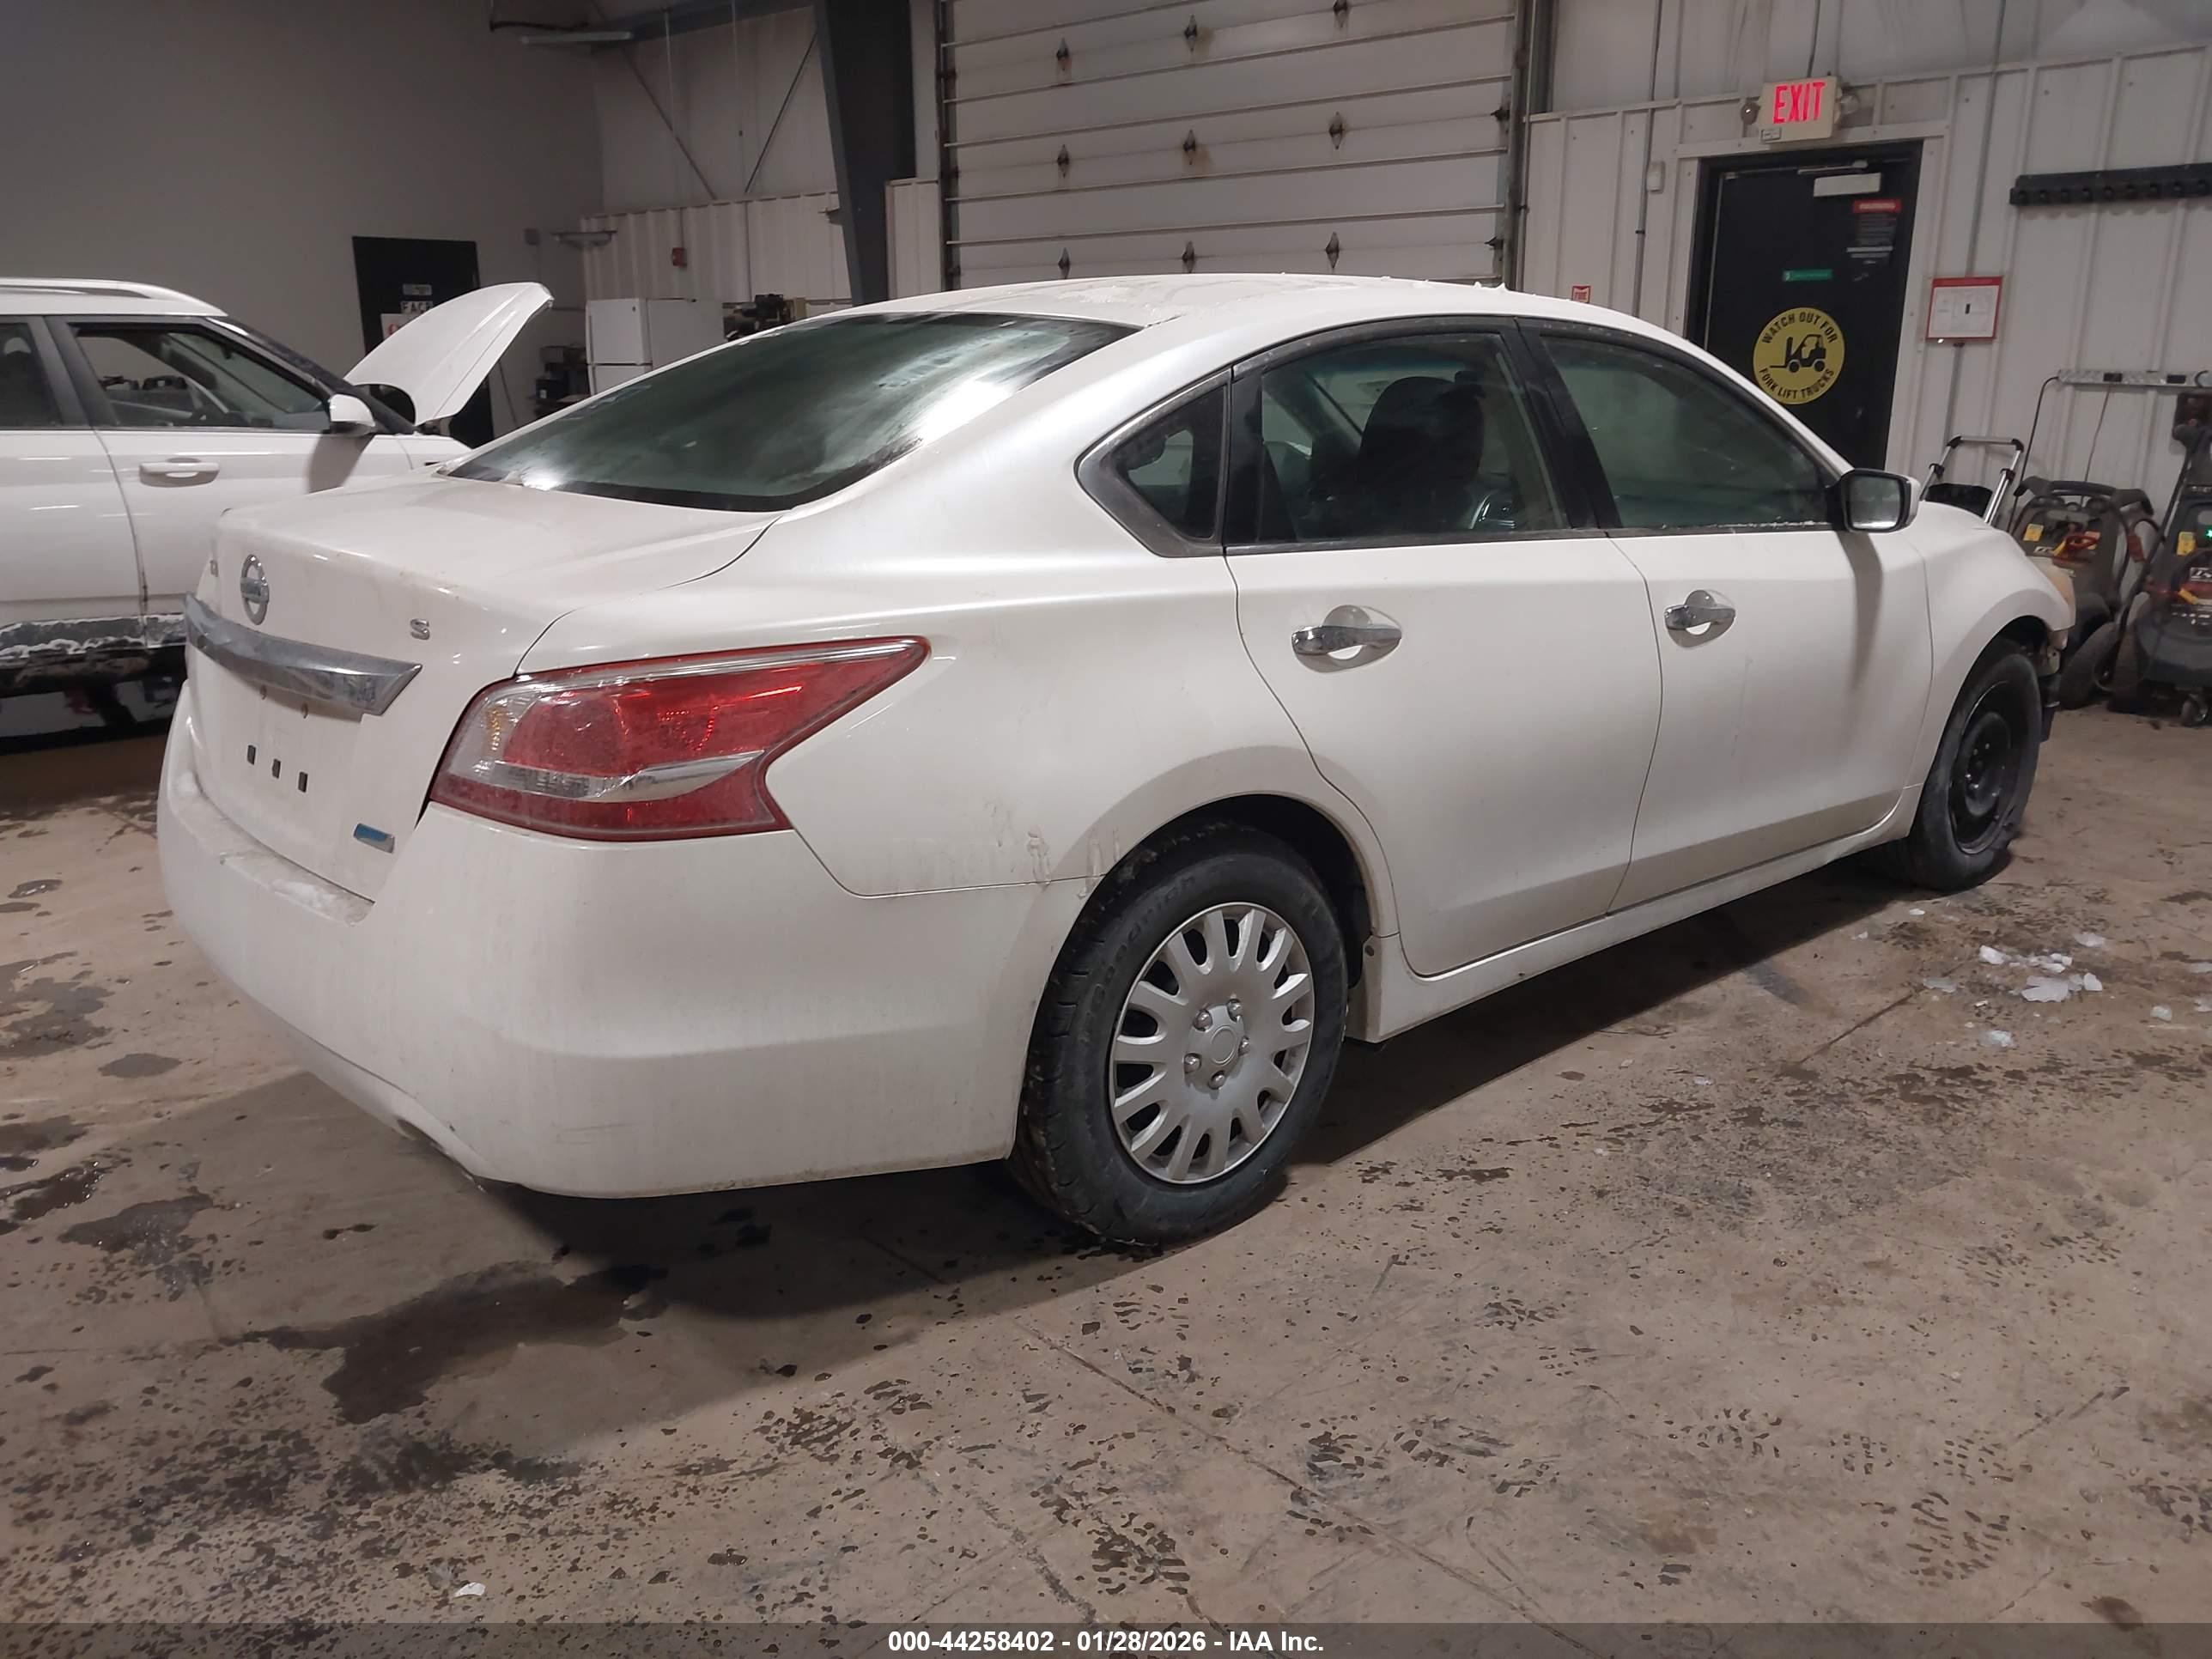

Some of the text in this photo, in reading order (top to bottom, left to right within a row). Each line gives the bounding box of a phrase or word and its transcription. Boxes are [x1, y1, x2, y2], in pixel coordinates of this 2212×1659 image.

[1772, 82, 1826, 125] EXIT
[1762, 312, 1838, 343] WATCH OUT FOR
[1759, 368, 1834, 400] FORK LIFT TRUCKS
[410, 618, 430, 641] S
